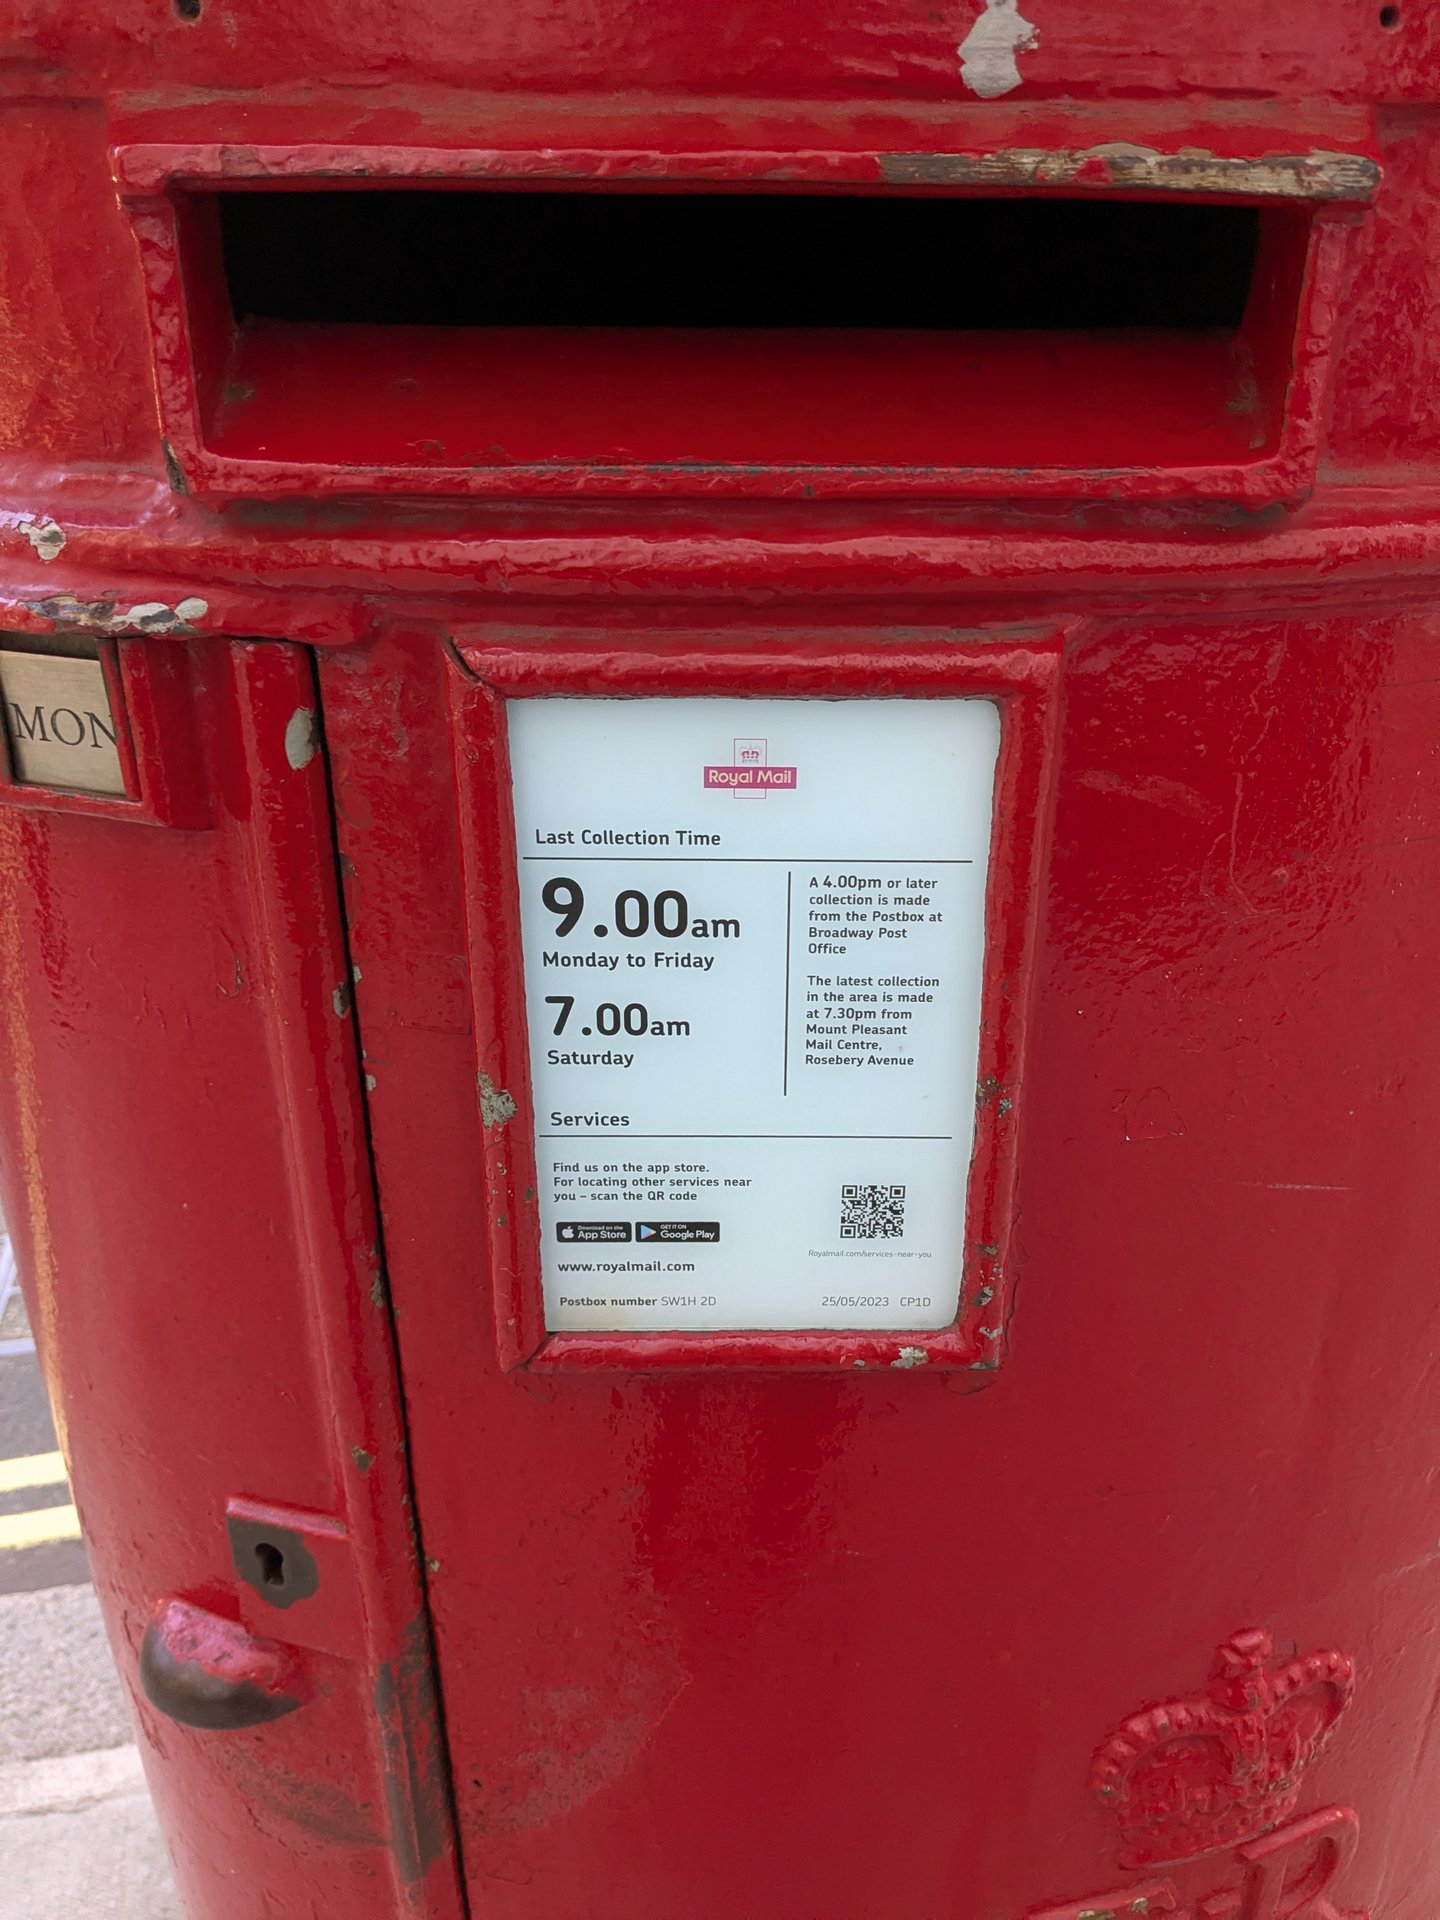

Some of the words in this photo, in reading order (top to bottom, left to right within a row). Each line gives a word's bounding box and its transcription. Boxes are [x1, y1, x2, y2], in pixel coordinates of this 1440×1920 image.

[9, 702, 117, 748] MON
[709, 769, 753, 786] Royal
[757, 770, 792, 784] Mail
[536, 829, 575, 844] Last
[582, 830, 669, 845] Collection
[675, 831, 720, 845] Time
[810, 877, 818, 888] A
[823, 875, 881, 891] 4.00pm
[887, 880, 901, 888] or
[906, 878, 938, 888] later
[810, 894, 872, 905] collection
[878, 894, 888, 905] is
[894, 895, 930, 905] made
[542, 877, 739, 938] 9.00am
[809, 910, 840, 921] from
[846, 911, 867, 921] the
[873, 911, 924, 921] Postbox
[929, 912, 942, 922] at
[809, 927, 873, 940] Broadway
[879, 928, 907, 938] Post
[809, 943, 846, 954] Office
[543, 951, 619, 971] Monday
[626, 954, 645, 967] to
[655, 952, 714, 971] Friday
[807, 976, 831, 986] The
[837, 976, 873, 986] latest
[878, 976, 939, 986] collection
[807, 991, 818, 1001] in
[824, 992, 844, 1001] the
[849, 994, 877, 1002] area
[883, 992, 893, 1002] is
[898, 992, 933, 1002] made
[545, 996, 689, 1036] 7.00am
[807, 1009, 819, 1018] at
[824, 1008, 876, 1021] 7.30pm
[881, 1009, 912, 1019] from
[807, 1024, 847, 1034] Mount
[852, 1024, 907, 1034] Pleasant
[806, 1039, 832, 1049] Mail
[838, 1040, 882, 1051] Centre,
[548, 1050, 634, 1068] Saturday
[806, 1055, 864, 1067] Rosebery
[868, 1055, 914, 1065] Avenue
[551, 1112, 629, 1126] Services
[553, 1162, 579, 1172] Find
[623, 1163, 642, 1172] the
[647, 1165, 669, 1174] app
[675, 1164, 709, 1172] store.
[554, 1177, 574, 1186] For
[578, 1177, 627, 1188] locating
[632, 1177, 665, 1186] other
[670, 1177, 719, 1186] services
[554, 1194, 576, 1202] you
[623, 1191, 642, 1200] the
[648, 1191, 664, 1200] QR
[670, 1191, 697, 1200] code
[578, 1231, 599, 1240] App
[600, 1231, 627, 1239] Store
[660, 1230, 695, 1240] Google
[696, 1230, 715, 1240] Play
[809, 1250, 932, 1259] Royalmail.com/services-near-you
[558, 1261, 694, 1273] www.royalmail.com
[560, 1297, 606, 1307] Postbox
[611, 1297, 657, 1306] number
[662, 1297, 695, 1306] SW1H
[701, 1297, 716, 1305] 2D
[822, 1296, 889, 1306] 25/05/2023
[900, 1297, 931, 1307] CP1D
